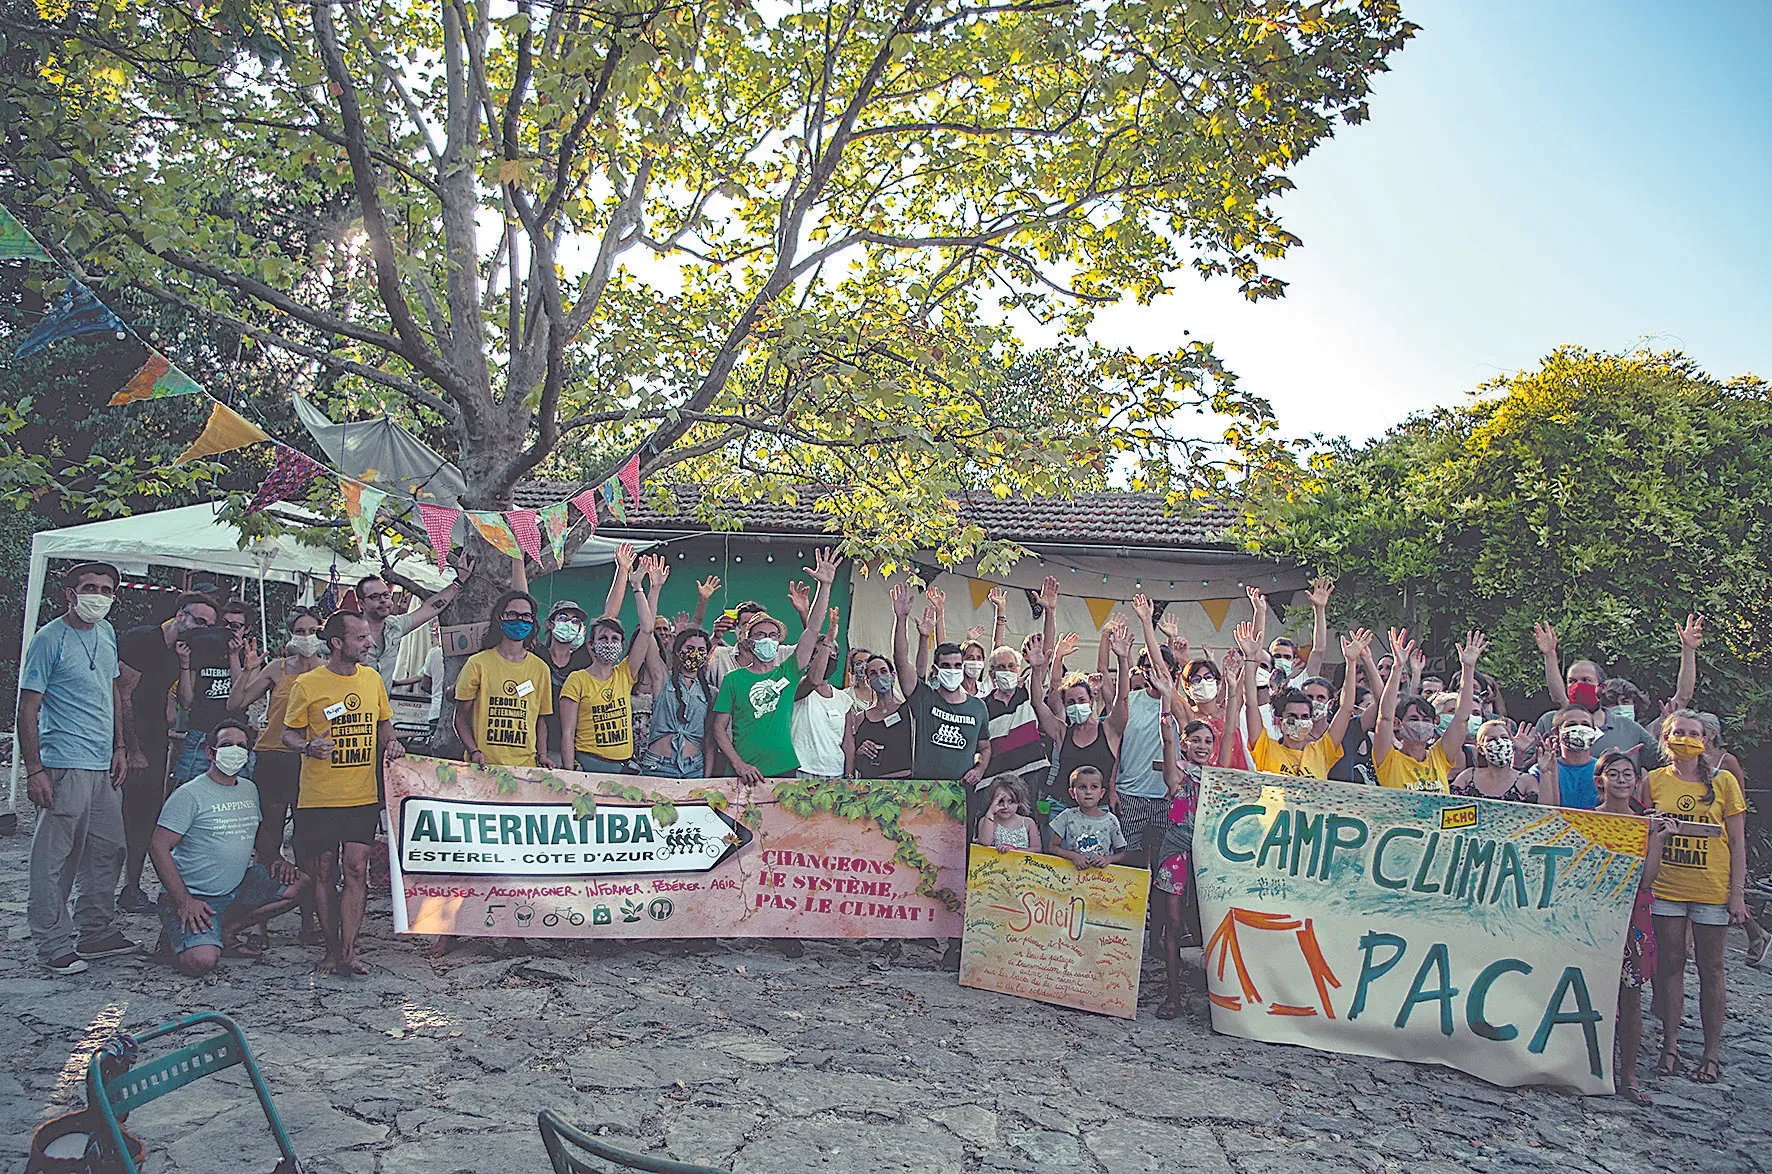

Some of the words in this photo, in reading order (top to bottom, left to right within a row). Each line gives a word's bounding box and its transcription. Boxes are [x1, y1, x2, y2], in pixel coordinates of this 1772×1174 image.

[489, 696, 517, 707] DEBOUT
[520, 700, 527, 709] ET
[365, 712, 373, 723] ET
[487, 718, 513, 729] POUR
[518, 720, 528, 730] LE
[931, 706, 976, 726] ALTERNATIBA
[594, 720, 617, 732] POUR
[364, 737, 373, 746] LE
[487, 728, 528, 745] CLIMAT
[595, 728, 628, 744] CLIMAT
[331, 748, 372, 764] CLIMAT
[410, 809, 655, 845] ALTERNATIBA
[1696, 840, 1708, 850] LE
[522, 851, 576, 864] CÔTE
[583, 851, 654, 863] D'AZUR
[761, 850, 896, 875] CHANGEONS
[1217, 805, 1369, 881] CAMP
[1372, 828, 1573, 909] CLIMAT
[1662, 846, 1708, 866] CLIMAT
[710, 875, 741, 891] AGIR
[758, 870, 787, 888] LE
[792, 875, 898, 900] SYSTÈME,
[755, 893, 797, 910] PAS
[804, 896, 833, 914] LE
[839, 900, 922, 921] CLIMAT
[928, 908, 935, 922] !
[1347, 930, 1605, 1080] PACA
